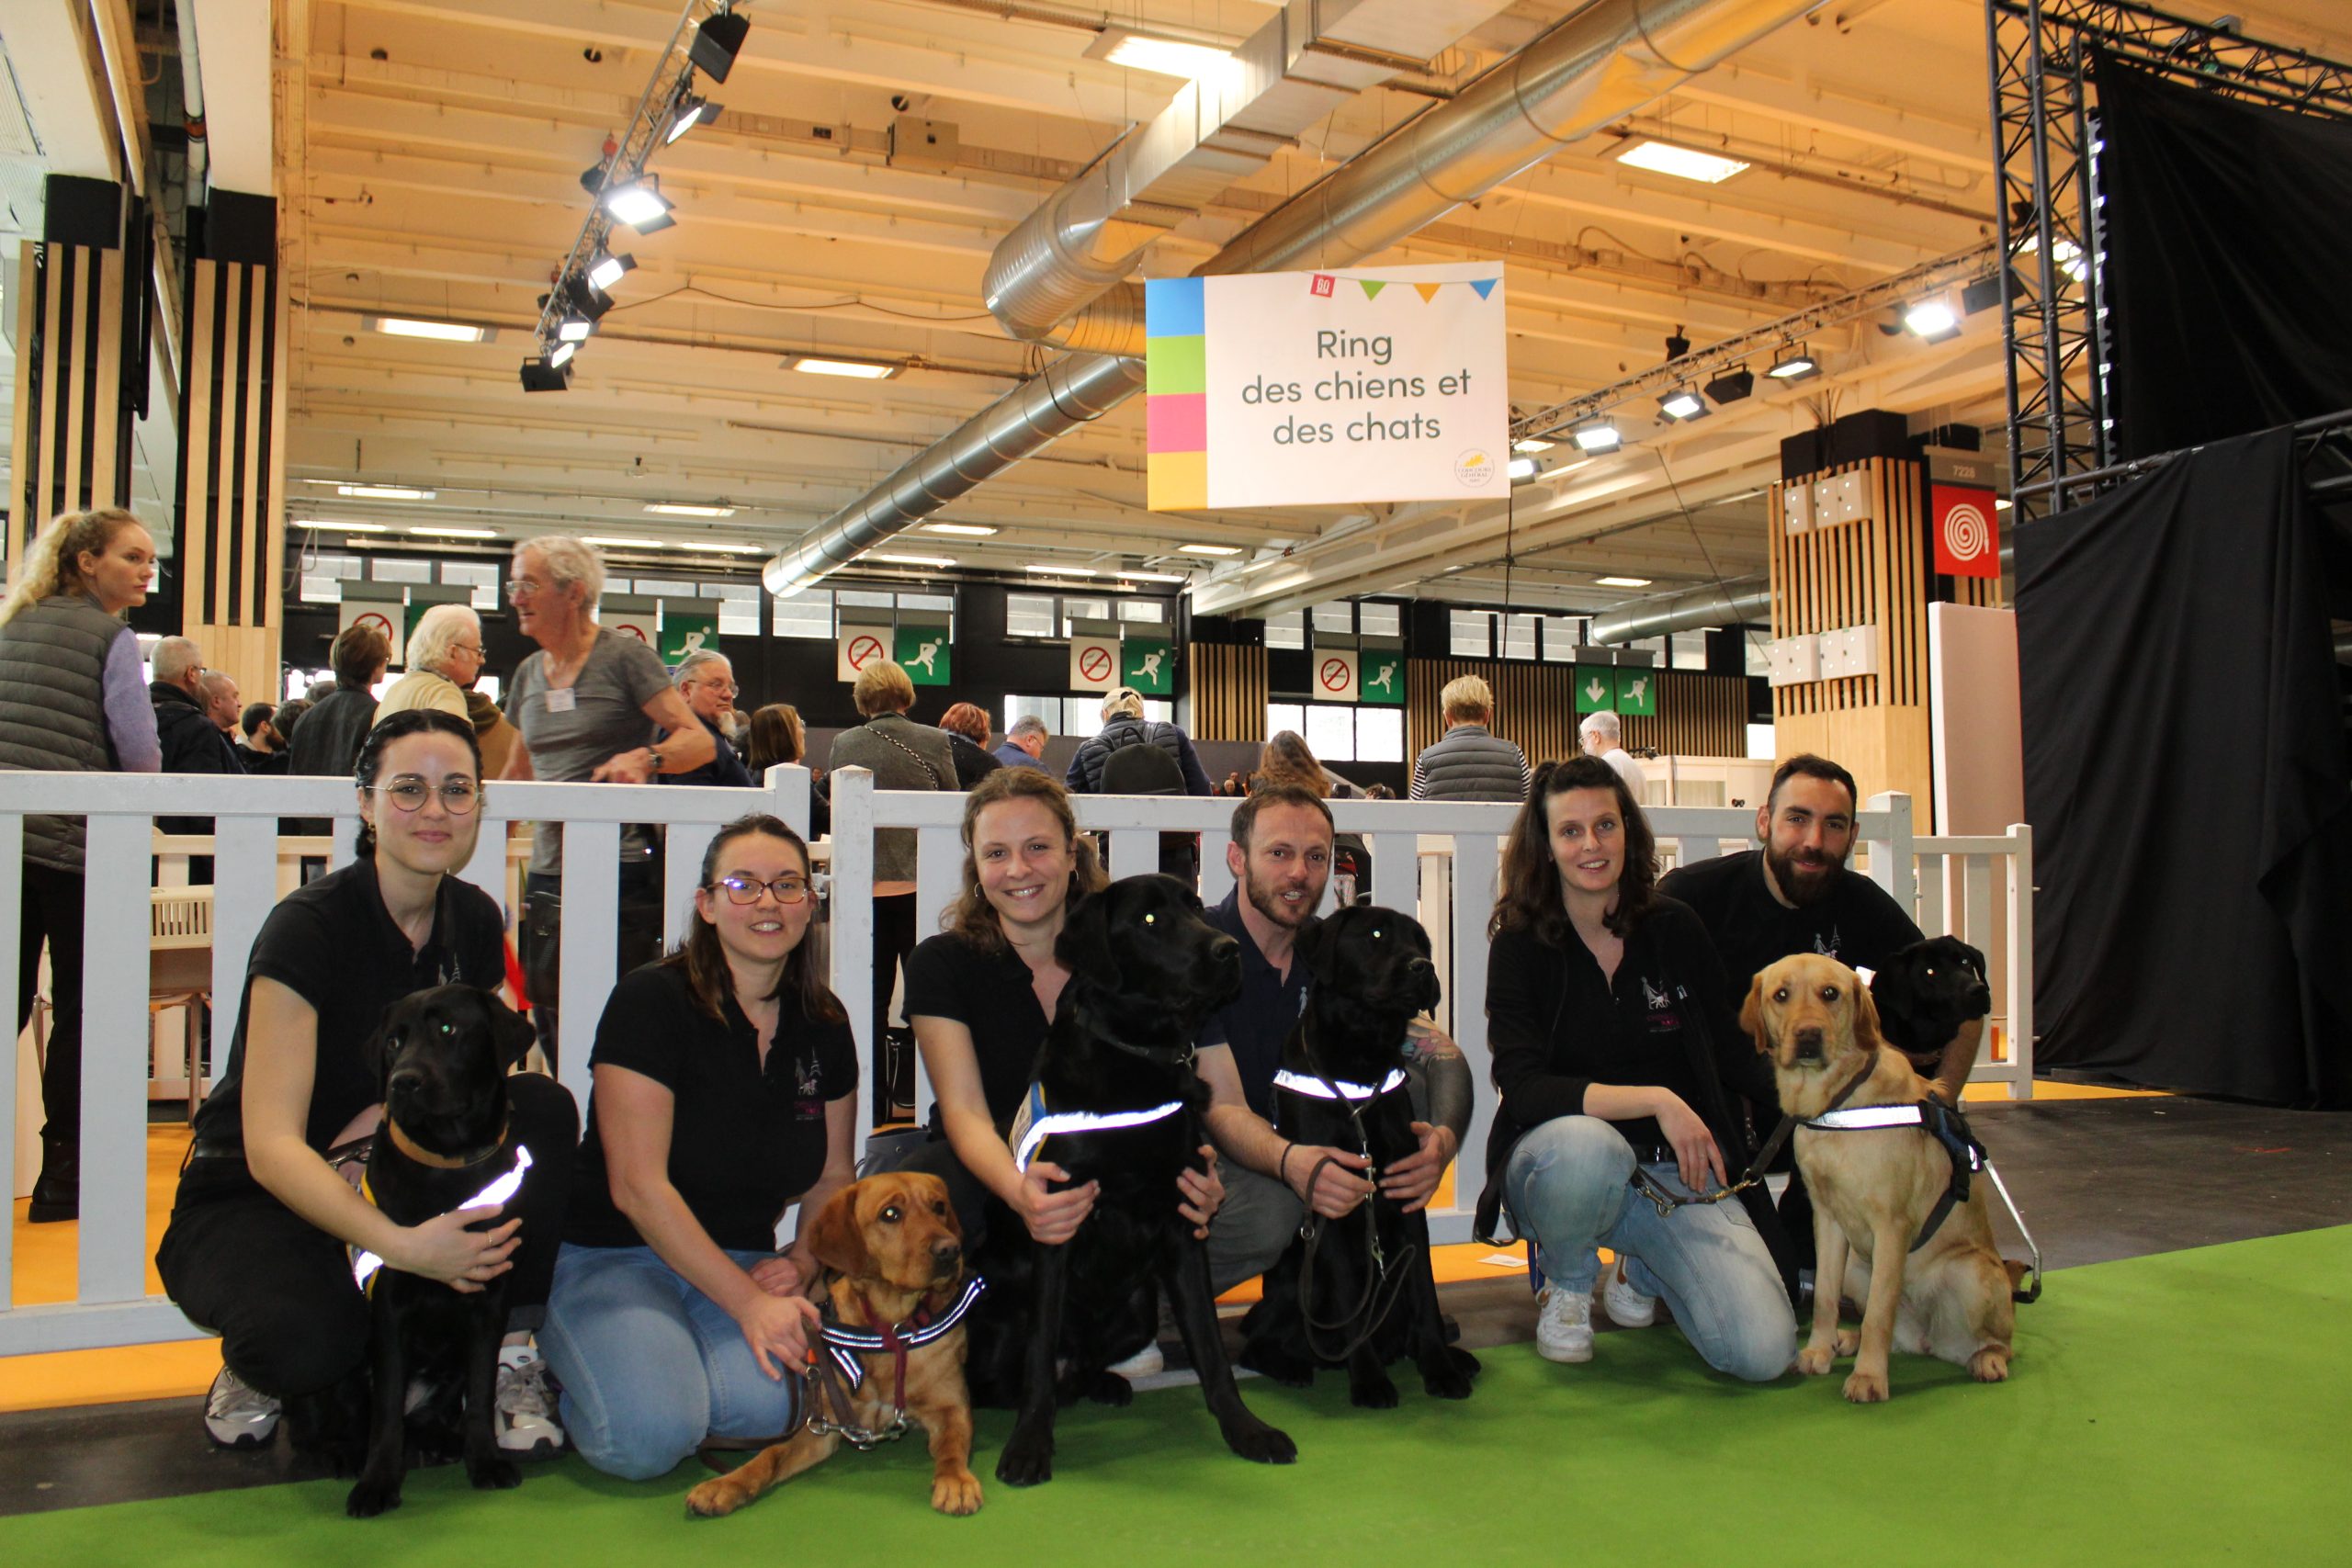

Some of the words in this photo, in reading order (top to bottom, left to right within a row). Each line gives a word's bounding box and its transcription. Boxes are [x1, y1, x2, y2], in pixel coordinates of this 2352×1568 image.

[1317, 329, 1393, 366] Ring
[1241, 375, 1302, 404] des
[1314, 370, 1426, 401] chiens
[1438, 368, 1472, 396] et
[1273, 415, 1334, 445] des
[1346, 412, 1441, 442] chats
